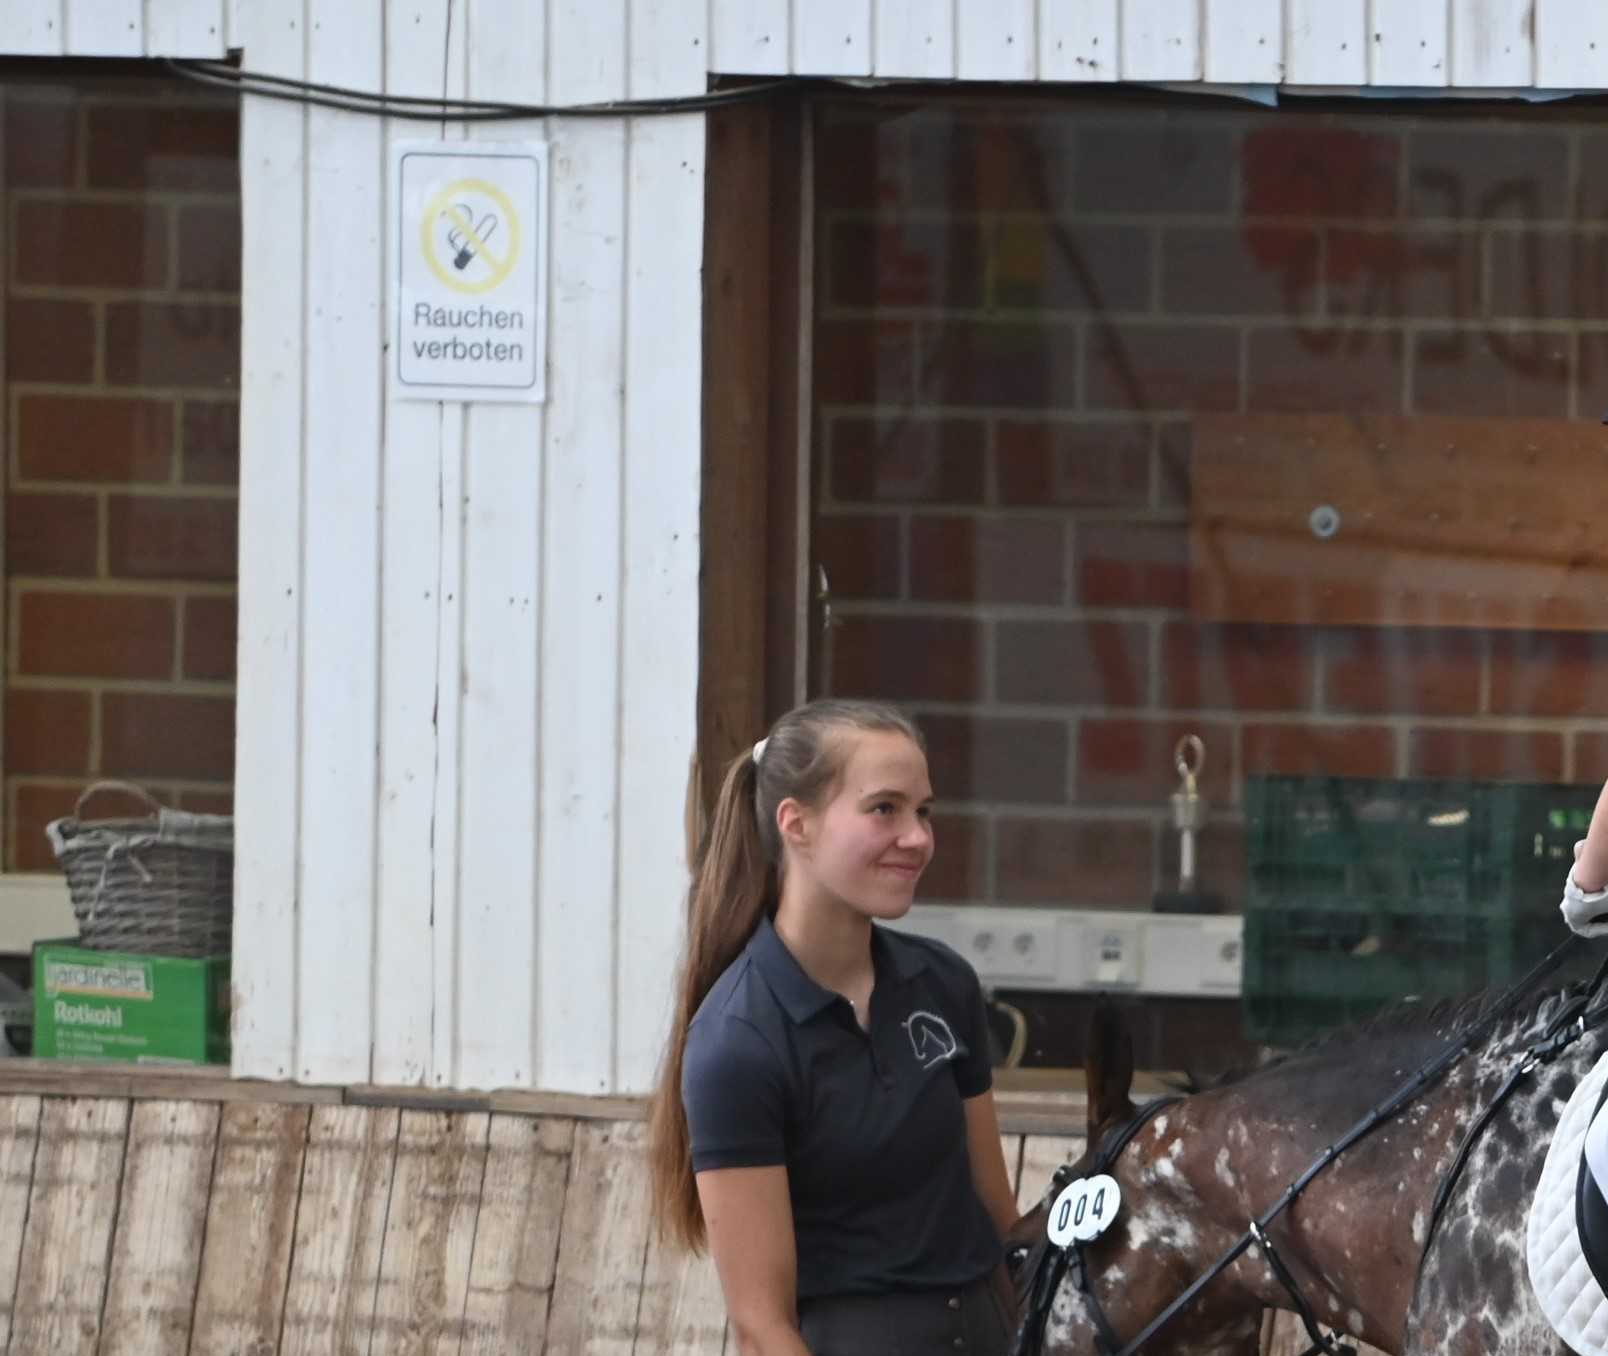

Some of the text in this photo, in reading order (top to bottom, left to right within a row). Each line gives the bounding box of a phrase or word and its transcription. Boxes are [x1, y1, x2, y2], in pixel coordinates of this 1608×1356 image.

[413, 303, 524, 329] Rauchen
[413, 335, 523, 361] verboten
[54, 1001, 123, 1028] Rotkohl
[1058, 1187, 1105, 1232] 004
